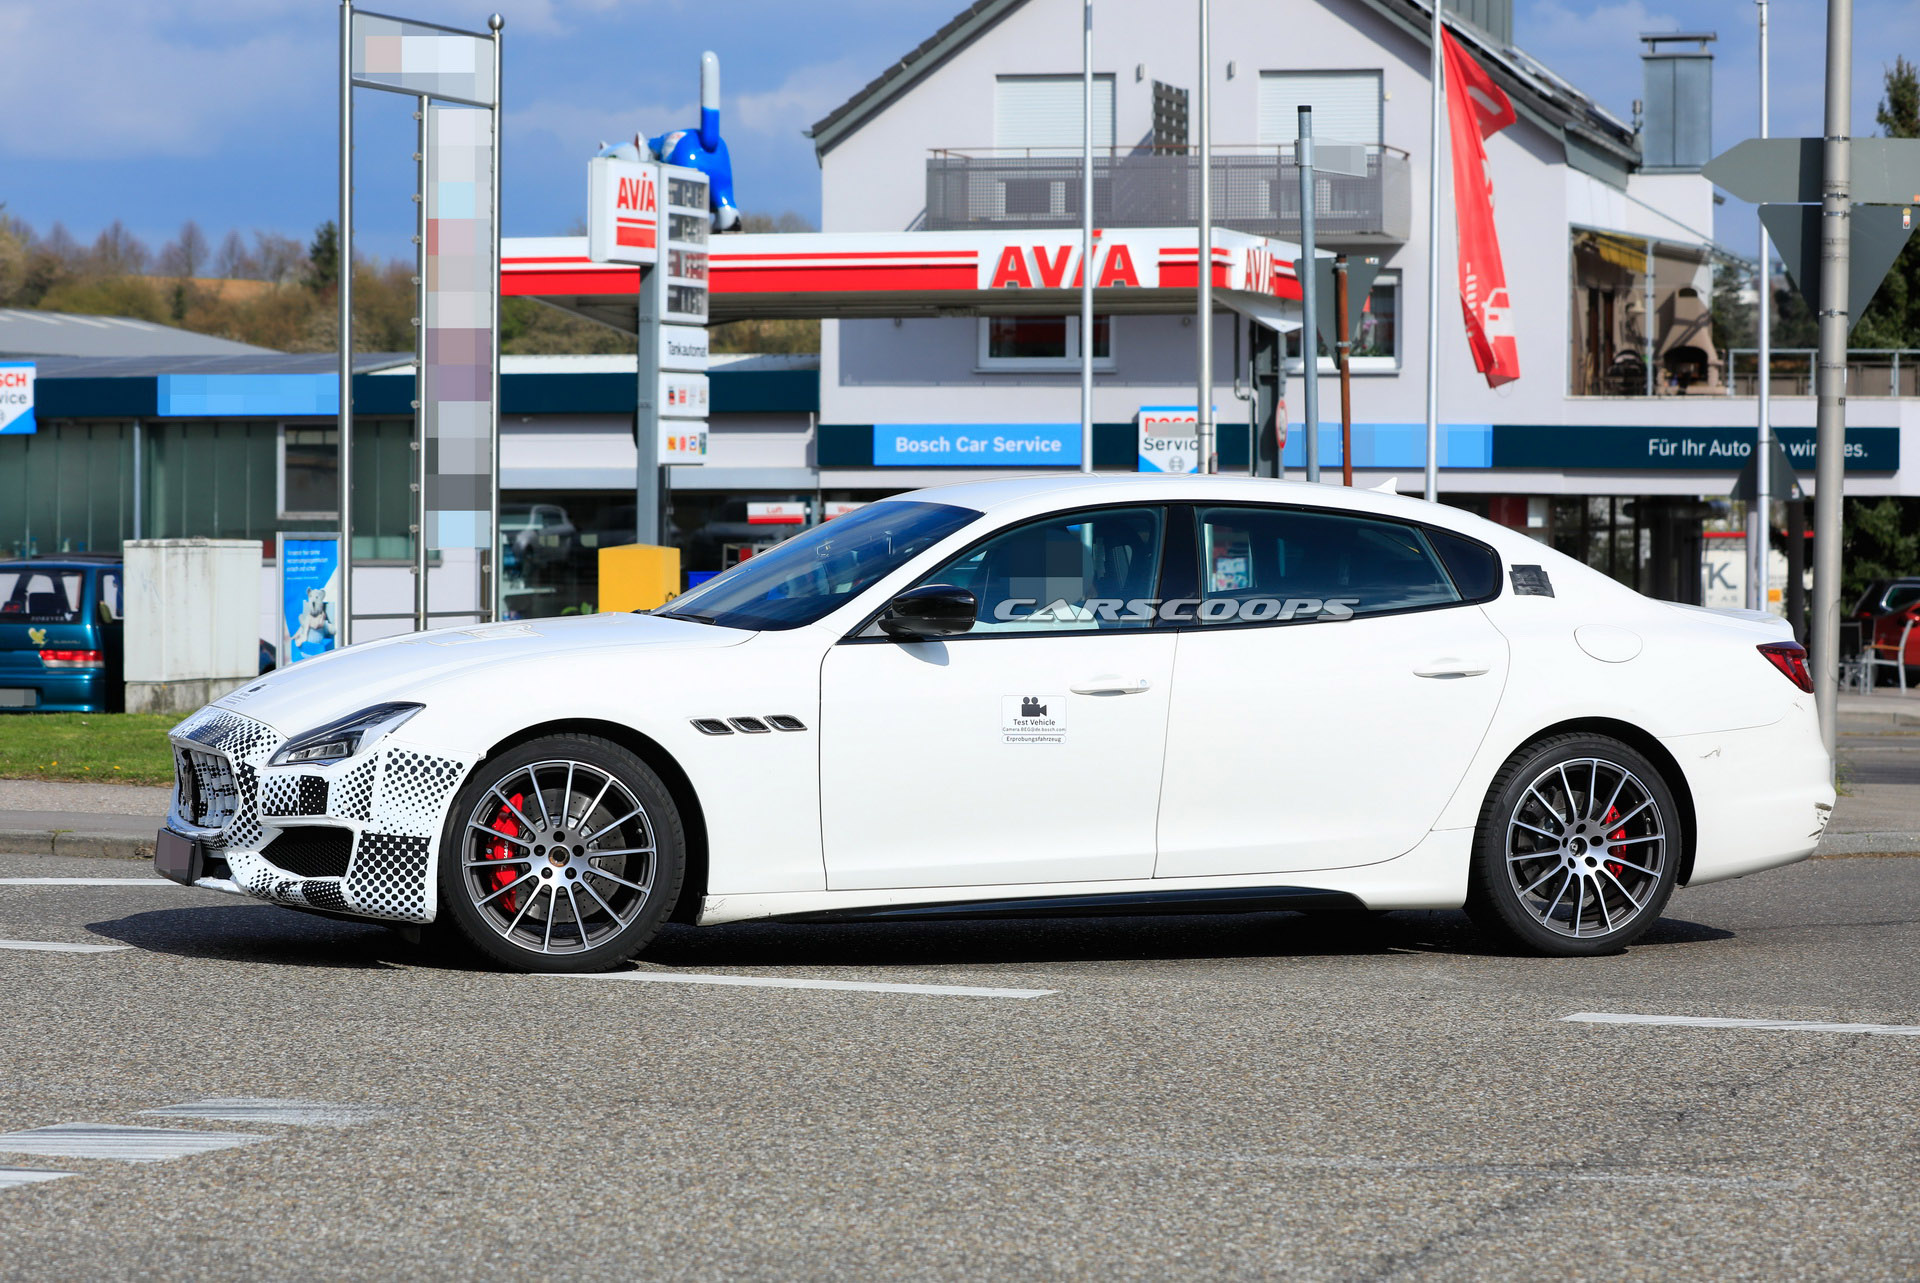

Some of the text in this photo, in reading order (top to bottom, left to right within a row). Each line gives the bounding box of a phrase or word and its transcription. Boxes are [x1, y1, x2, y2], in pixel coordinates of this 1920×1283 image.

[895, 436, 1062, 452] Bosch Car Service
[1144, 438, 1199, 451] Servic
[1648, 438, 1678, 456] Für
[1682, 438, 1705, 456] Ihr
[1709, 438, 1751, 457] Auto
[1013, 718, 1056, 726] Test Vehicle
[1006, 735, 1062, 743] Erprobungsfahrzeug
